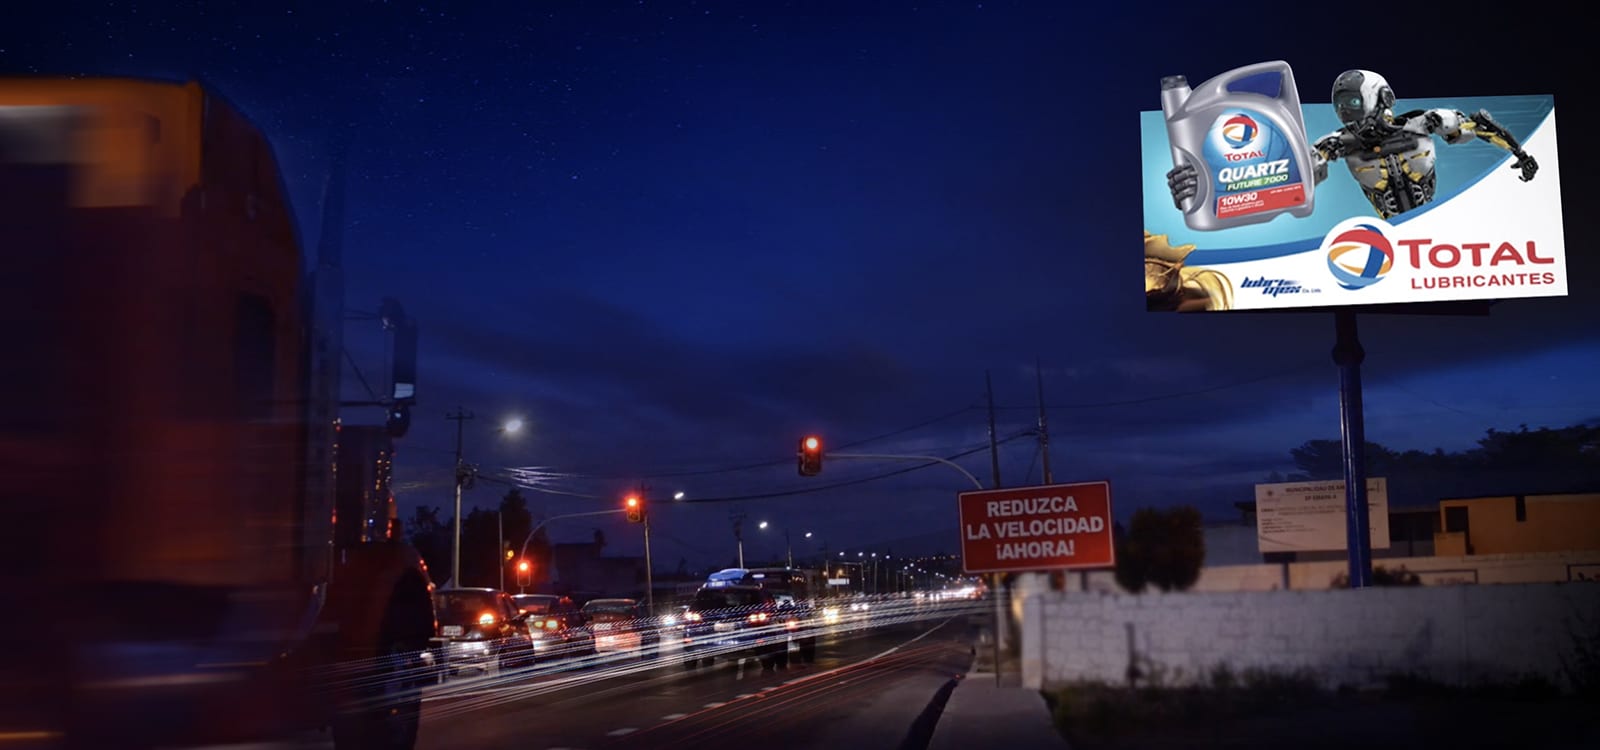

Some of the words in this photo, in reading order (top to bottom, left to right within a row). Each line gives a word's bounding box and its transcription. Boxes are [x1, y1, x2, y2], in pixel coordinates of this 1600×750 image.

[1224, 151, 1265, 162] TOTAL
[1218, 159, 1289, 183] QUARTZ
[1227, 179, 1262, 191] FUTURE
[1264, 174, 1288, 185] 7000
[1221, 192, 1258, 206] 10W30
[1398, 238, 1554, 269] TOTAL
[1411, 272, 1555, 290] LUBRICANTES
[987, 496, 1078, 518] REDUZCA
[967, 523, 991, 540] LA
[994, 516, 1104, 538] VELOCIDAD
[996, 540, 1075, 560] ¡AHORA!
